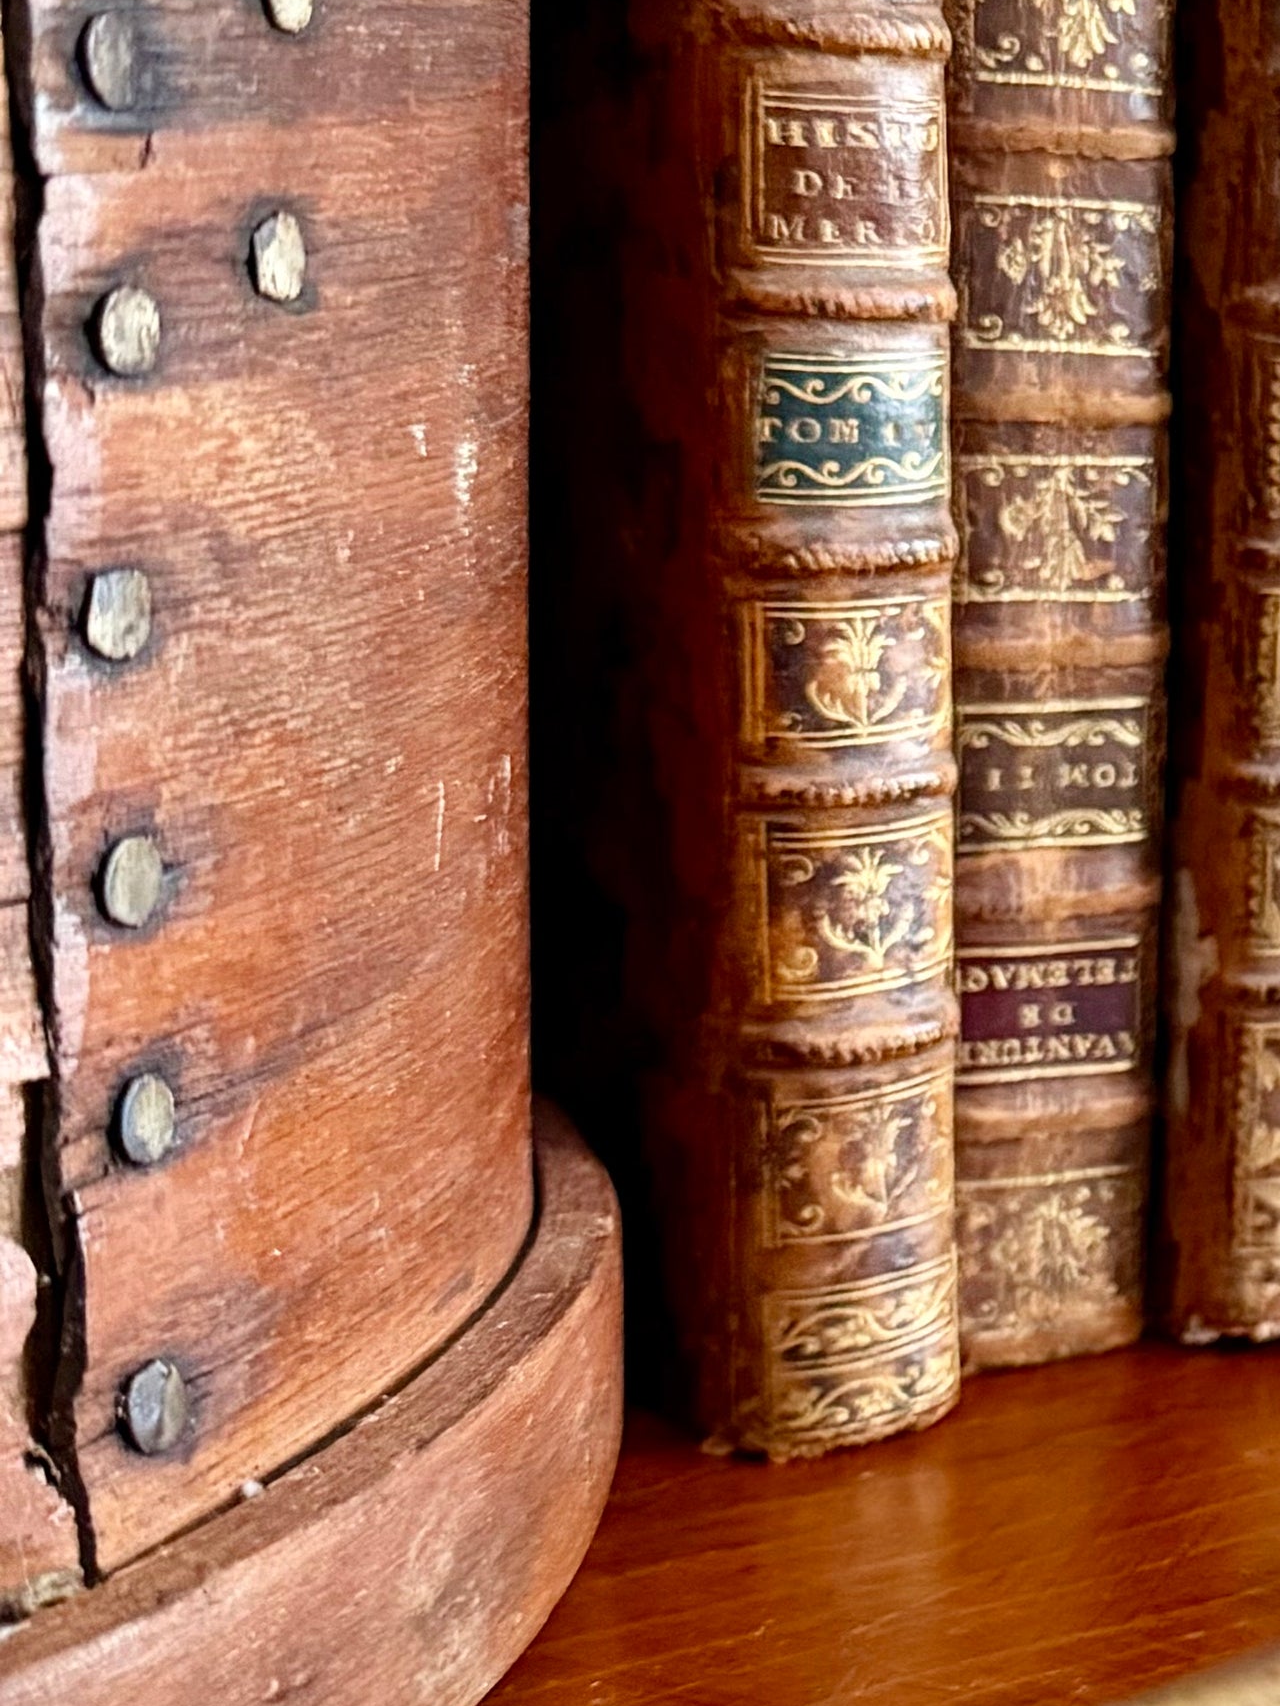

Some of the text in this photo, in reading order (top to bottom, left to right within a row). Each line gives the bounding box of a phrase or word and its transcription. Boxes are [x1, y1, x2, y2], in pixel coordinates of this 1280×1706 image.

[759, 416, 860, 444] TOM
[1059, 761, 1138, 788] TOM
[1019, 1000, 1077, 1029] DE
